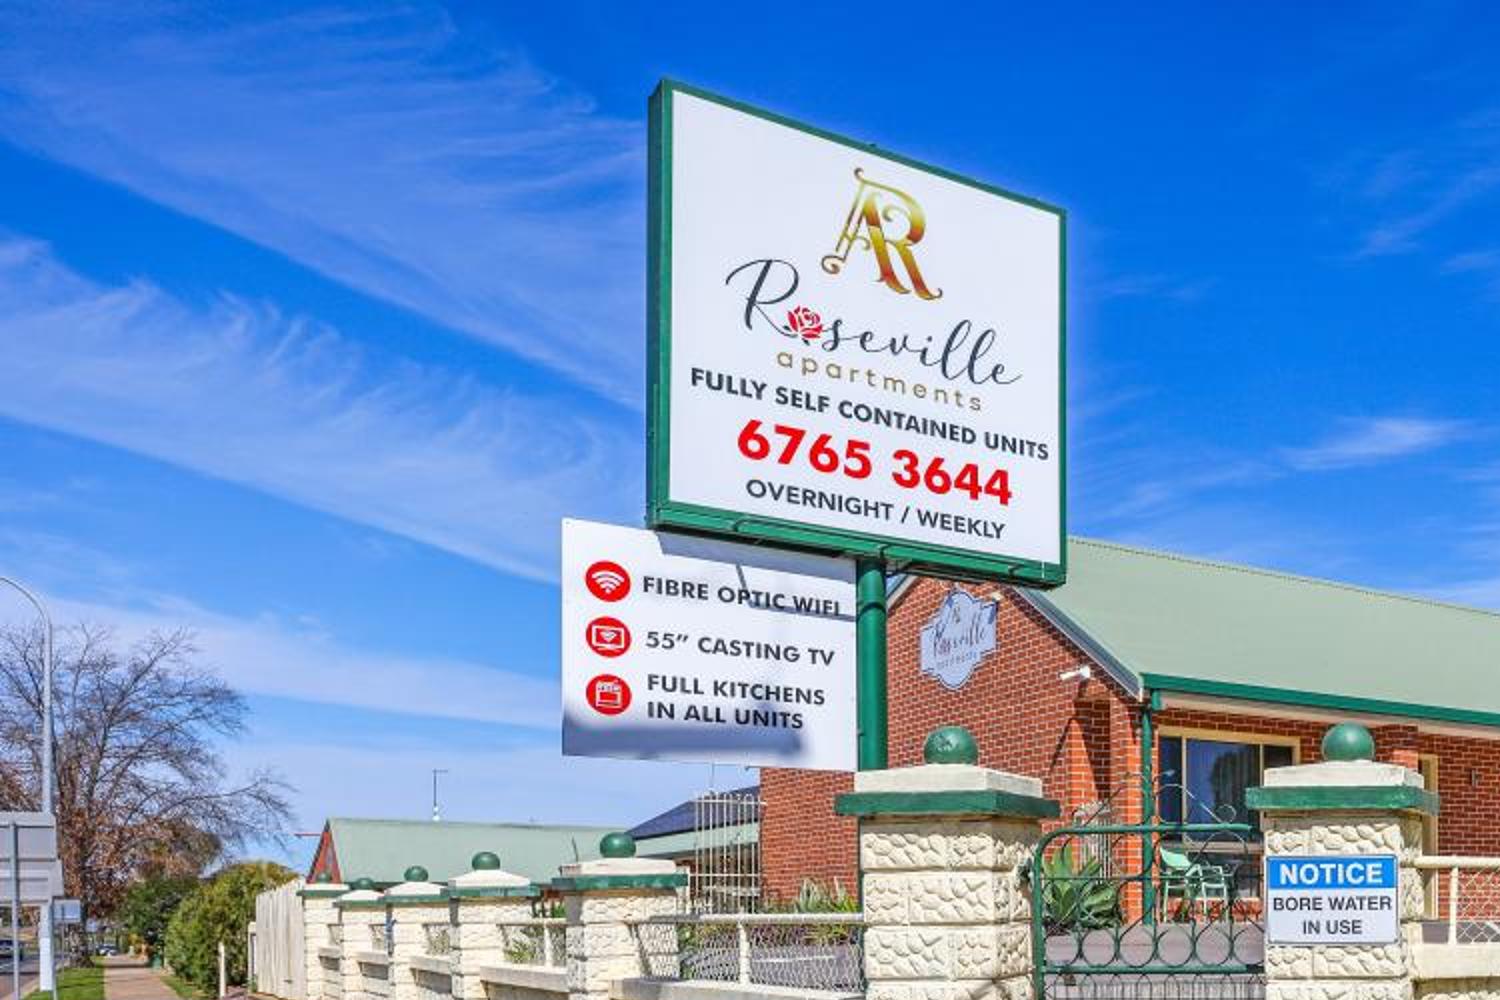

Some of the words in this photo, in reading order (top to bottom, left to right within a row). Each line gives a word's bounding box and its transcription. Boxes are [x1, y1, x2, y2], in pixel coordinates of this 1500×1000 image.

[777, 351, 982, 411] apartments
[691, 368, 767, 401] FULLY
[775, 386, 830, 413] SELF
[838, 400, 976, 445] CONTAINED
[985, 432, 1048, 460] UNITS
[737, 419, 872, 480] 6765
[892, 450, 1012, 506] 3644
[746, 479, 894, 521] OVERNIGHT
[900, 506, 909, 524] /
[917, 509, 1005, 540] WEEKLY
[643, 576, 708, 600] FIBRE
[717, 586, 785, 609] OPTIC
[793, 595, 841, 616] WIFI
[697, 636, 800, 662] CASTING
[808, 648, 835, 666] TV
[647, 674, 704, 695] FULL
[713, 680, 825, 705] KITCHENS
[647, 701, 675, 719] IN
[684, 704, 727, 723] ALL
[735, 709, 803, 729] UNITS
[1279, 862, 1383, 885] NOTICE
[1273, 897, 1322, 911] BORE
[1328, 895, 1392, 911] WATER
[1303, 920, 1320, 934] IN
[1326, 919, 1363, 934] USE
